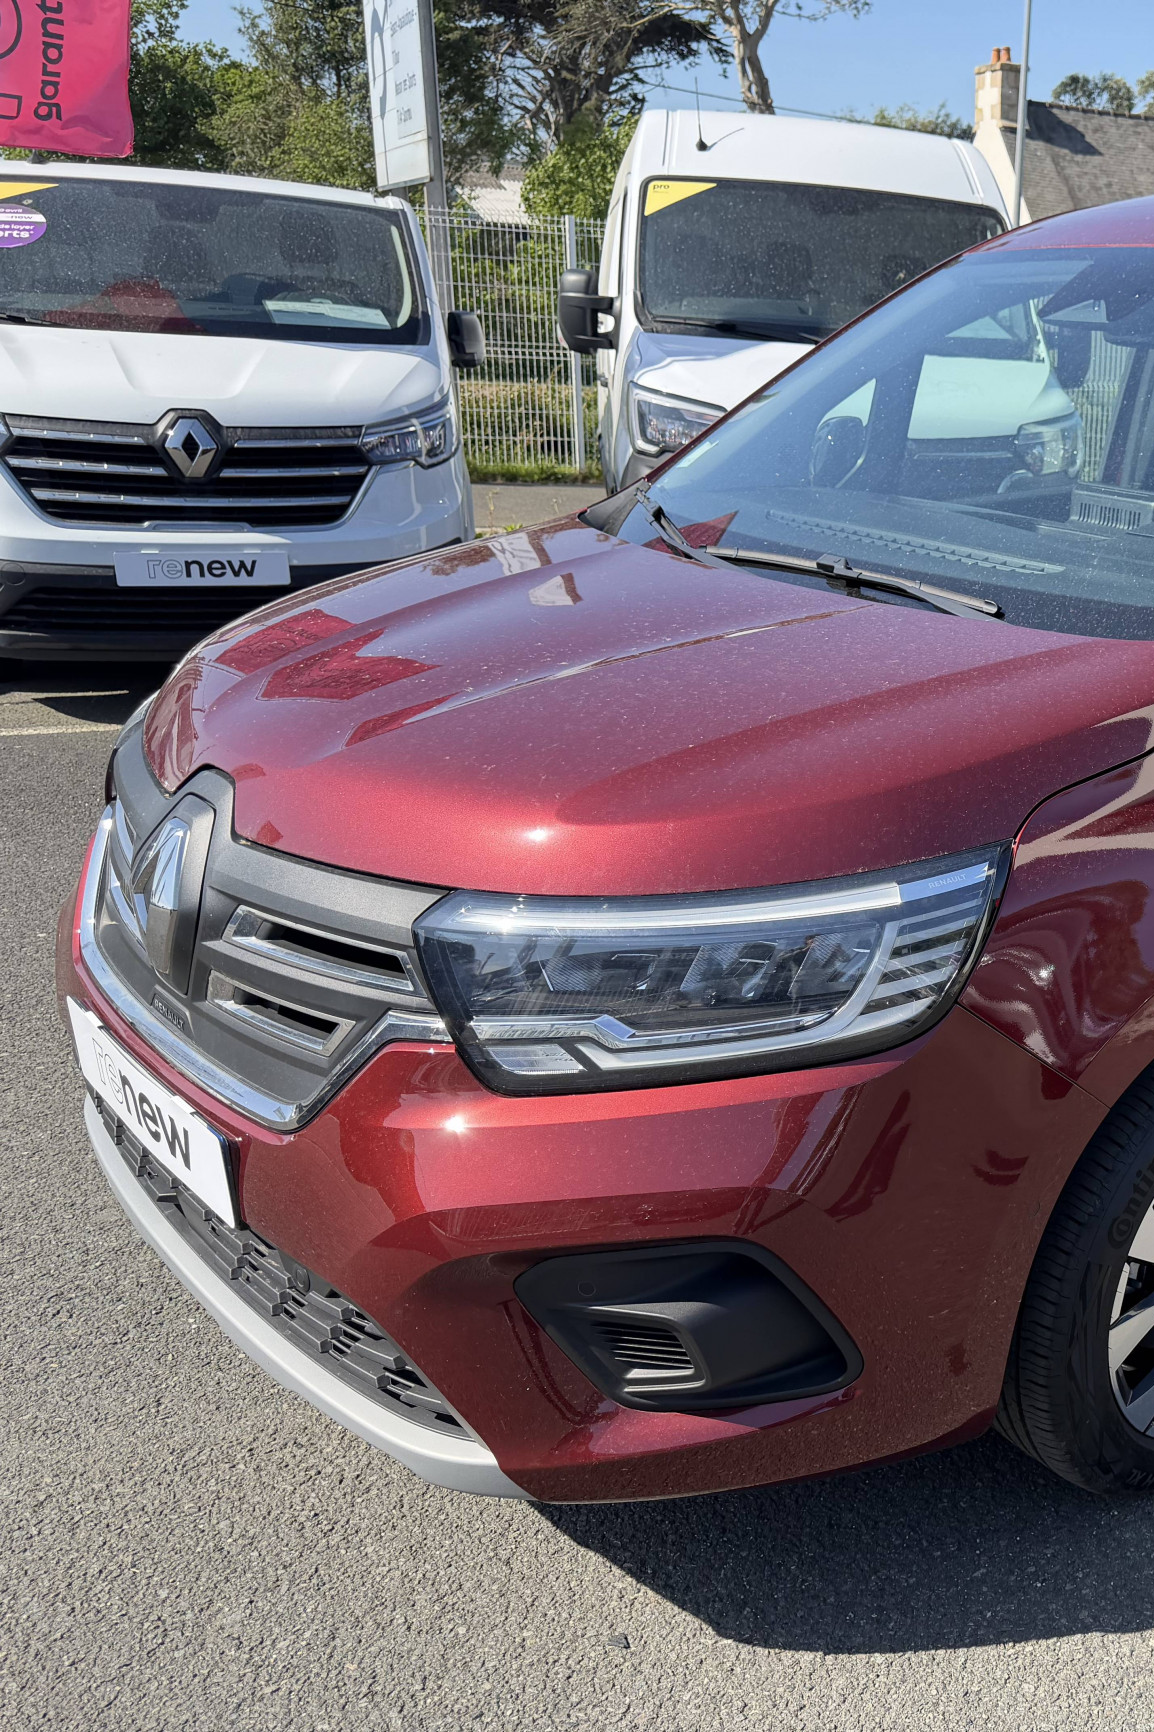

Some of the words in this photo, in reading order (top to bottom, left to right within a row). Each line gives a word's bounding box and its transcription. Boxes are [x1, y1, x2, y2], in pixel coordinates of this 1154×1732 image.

[147, 559, 257, 579] renew
[928, 873, 967, 889] RENAULT
[153, 999, 185, 1032] RENAULT
[92, 1037, 191, 1171] renew
